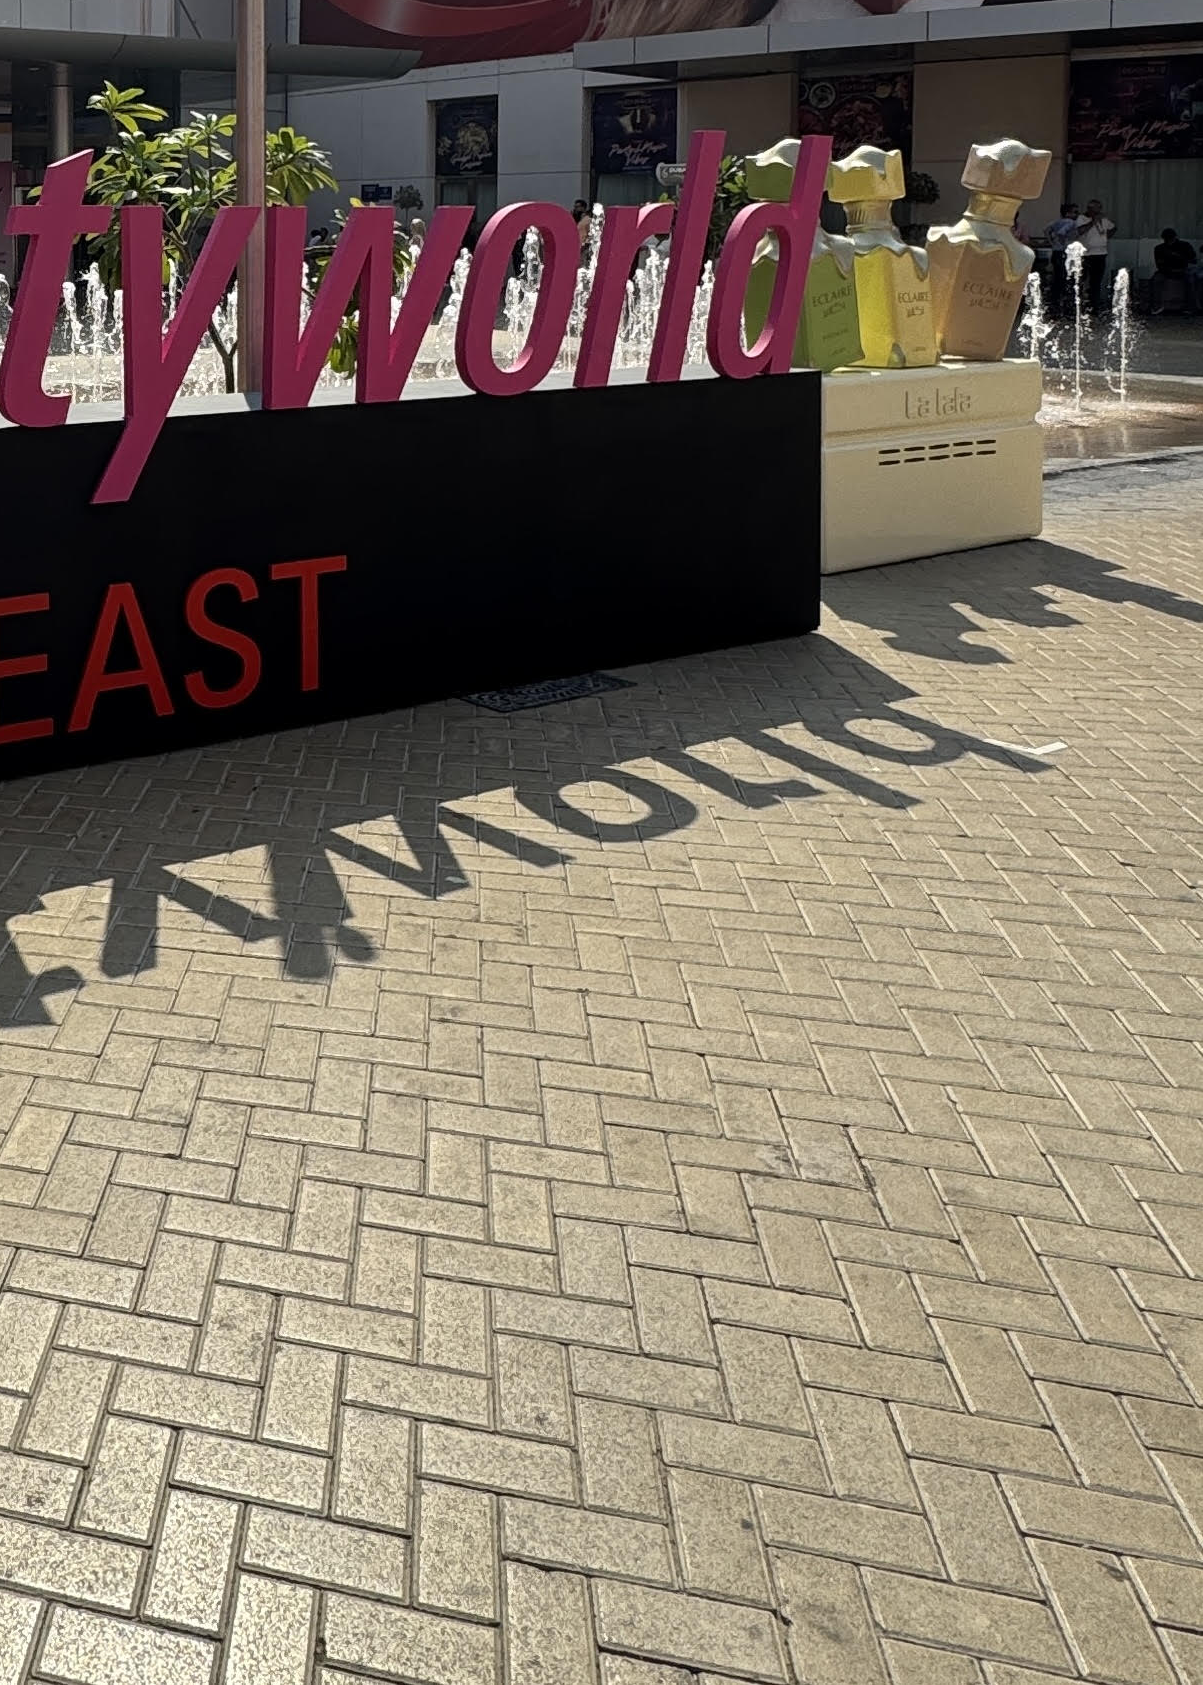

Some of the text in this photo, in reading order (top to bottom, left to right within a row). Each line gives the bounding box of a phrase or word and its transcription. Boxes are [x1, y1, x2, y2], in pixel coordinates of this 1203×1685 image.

[811, 282, 853, 308] ECLAIRE
[897, 290, 932, 304] ECLAIRE
[963, 281, 1015, 300] ECLAIRE
